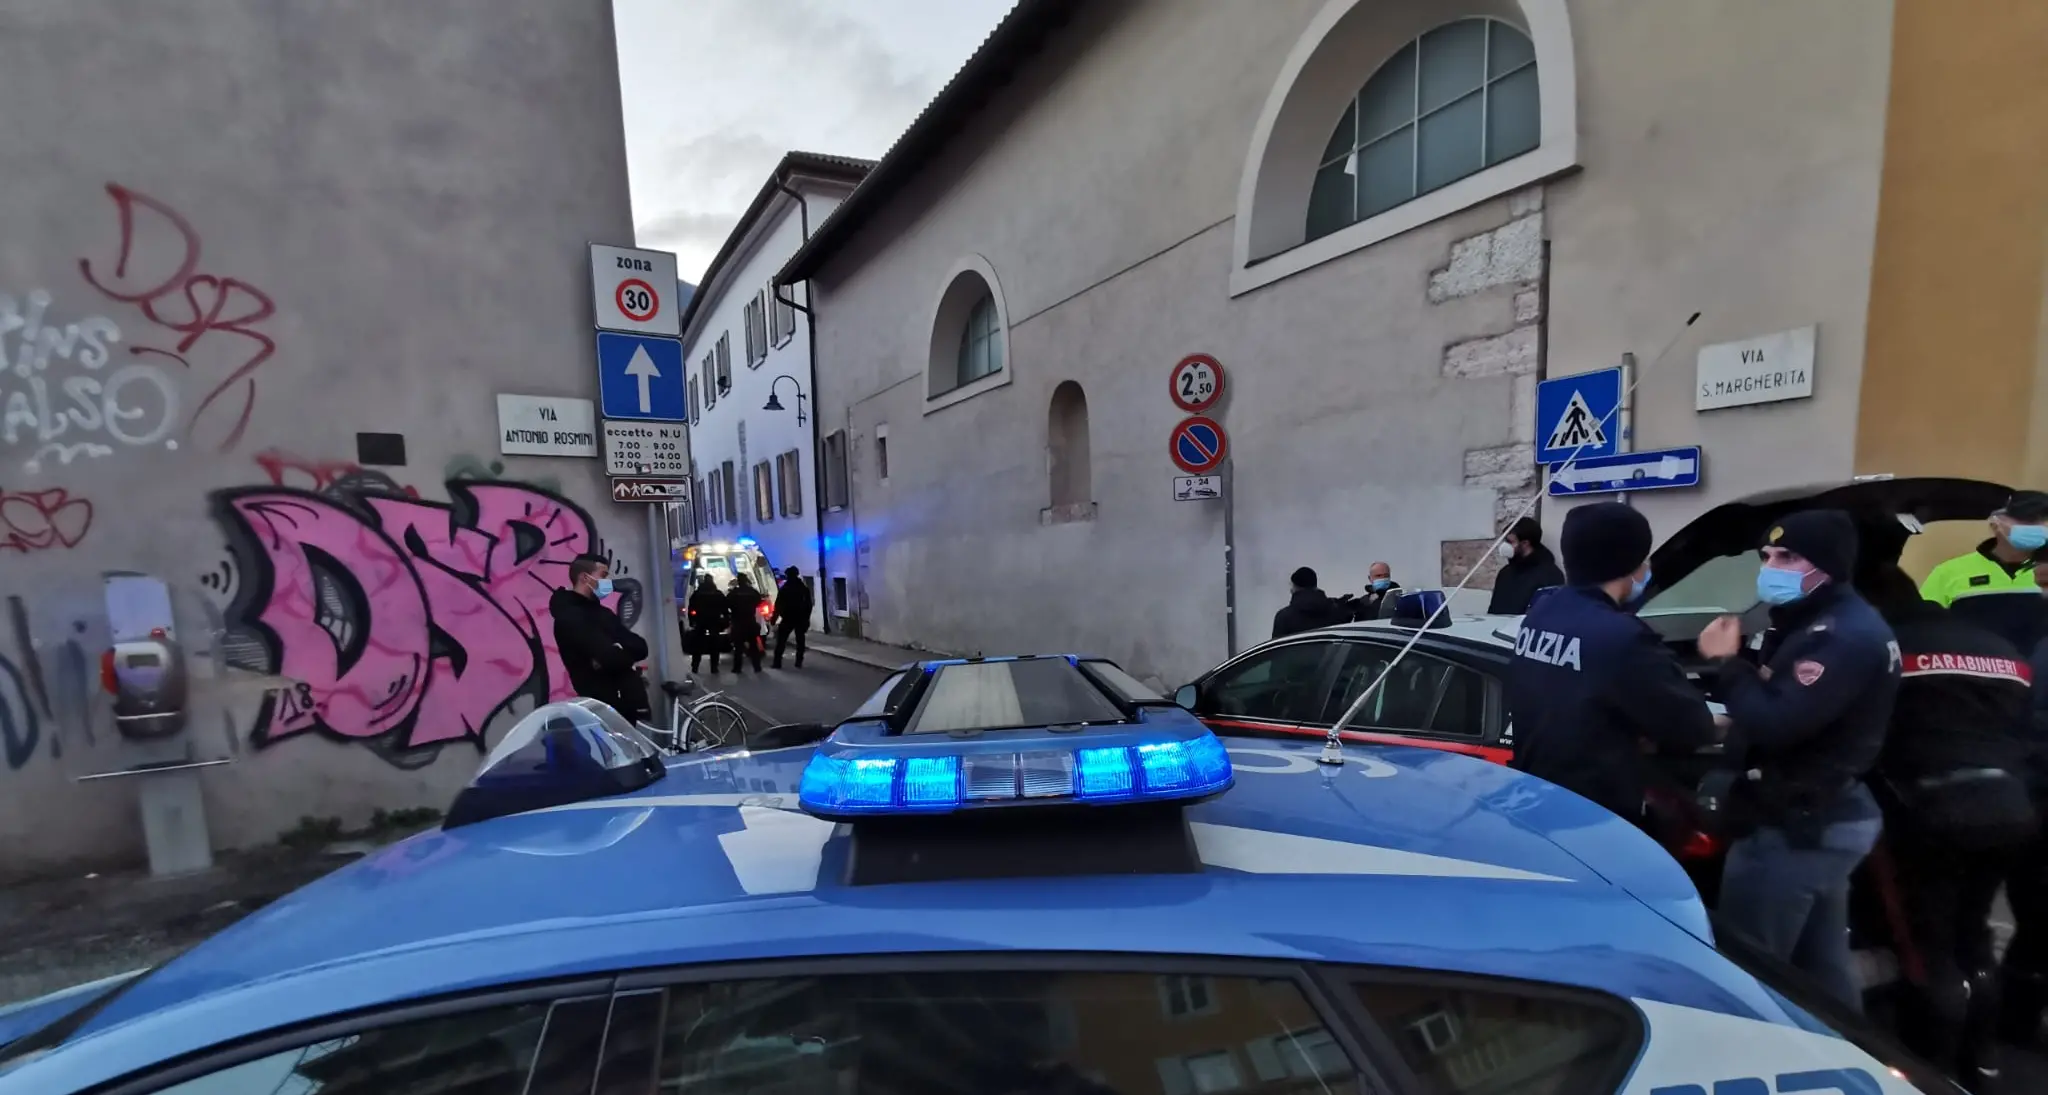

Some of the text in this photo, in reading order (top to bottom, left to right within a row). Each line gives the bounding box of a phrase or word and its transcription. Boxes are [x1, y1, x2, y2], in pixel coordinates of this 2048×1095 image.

[616, 256, 653, 273] zona
[625, 289, 650, 311] 30
[1741, 349, 1765, 365] VIA
[538, 406, 558, 422] VIA
[506, 429, 593, 446] ANTONIO ROSMINI
[606, 427, 654, 438] eccetto
[618, 441, 641, 450] 7.00
[653, 442, 676, 451] 9.00
[614, 451, 642, 460] 12.00
[654, 452, 681, 461] 14.00
[653, 462, 682, 470] 20.00
[1198, 477, 1209, 485] 24
[1515, 626, 1581, 671] OLIZIA
[1916, 653, 2018, 676] CARABINIERI
